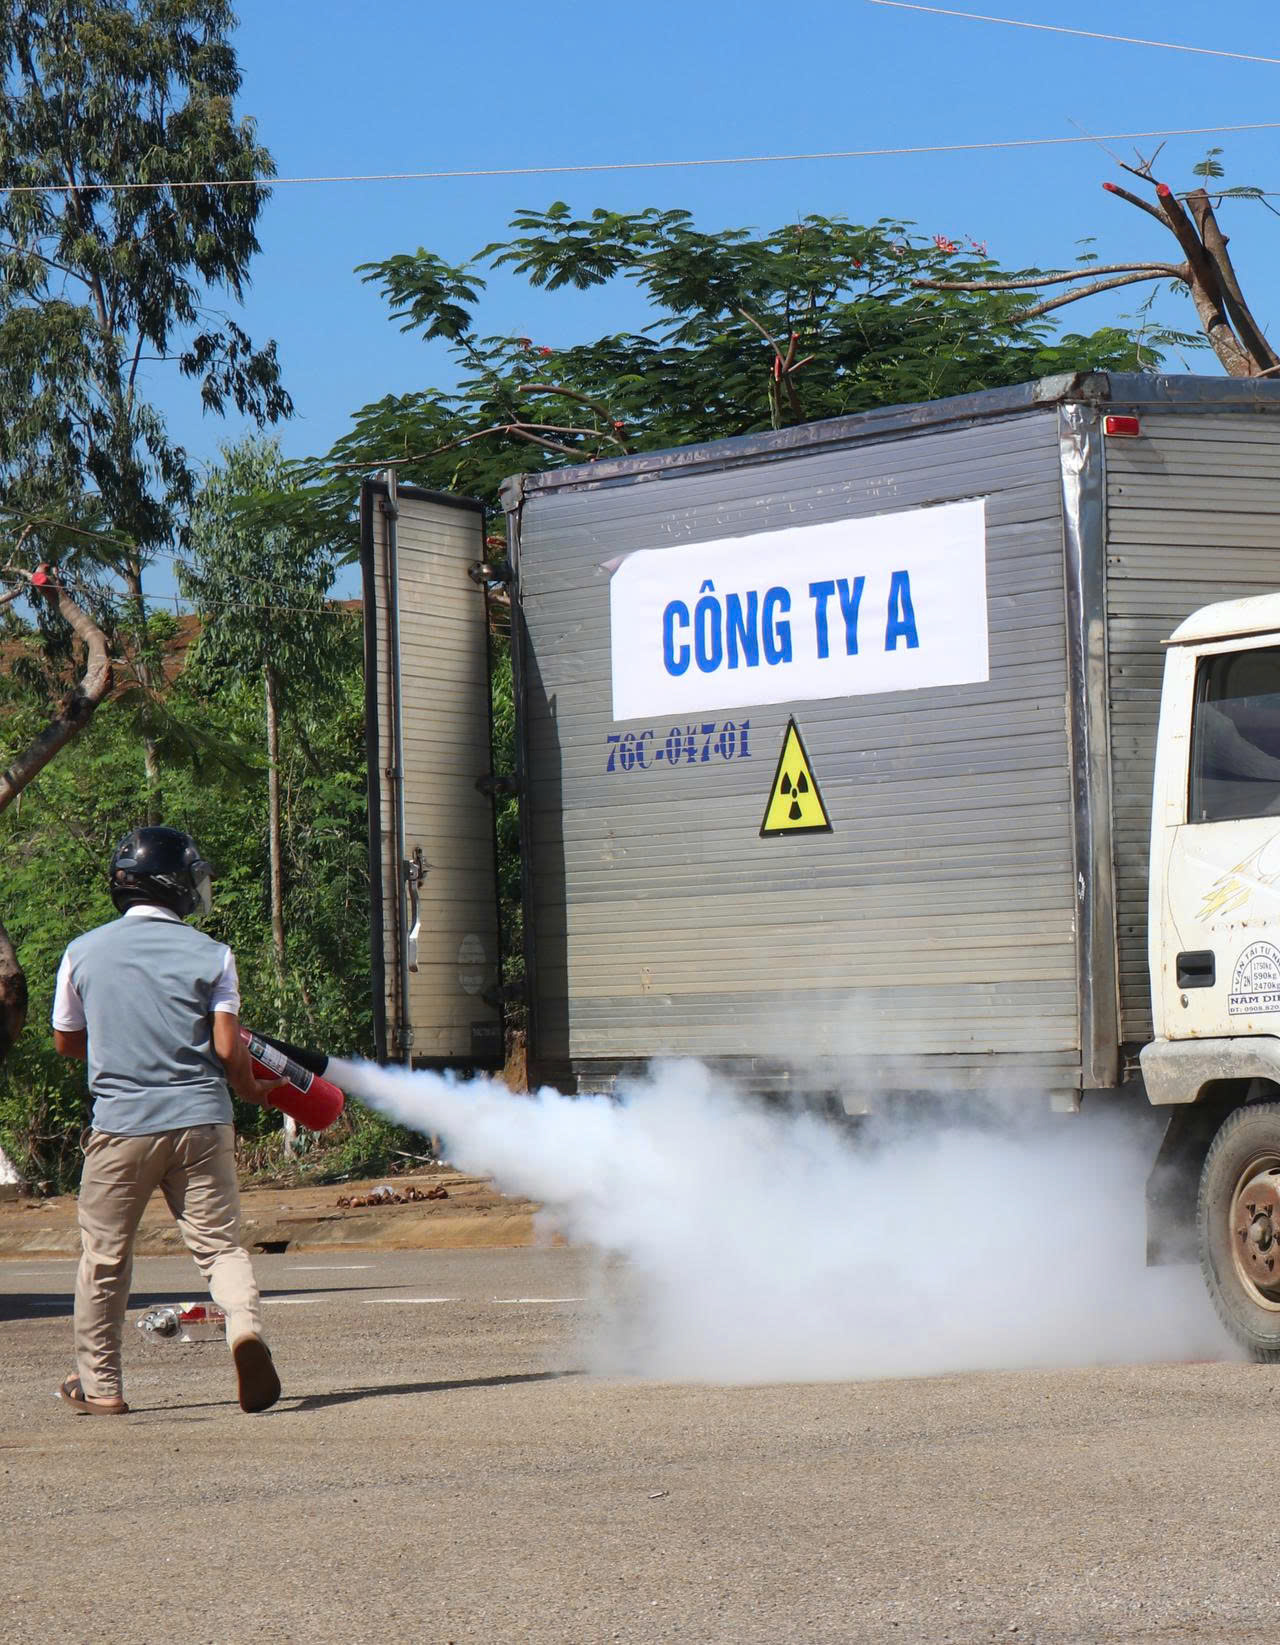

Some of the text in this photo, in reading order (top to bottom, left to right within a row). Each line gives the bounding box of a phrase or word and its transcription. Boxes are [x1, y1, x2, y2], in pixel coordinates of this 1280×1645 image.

[663, 570, 920, 677] CÔNG TY A
[606, 719, 752, 773] 76C-047.01
[1253, 972, 1278, 981] 590kg
[1253, 981, 1280, 991] 2470kg
